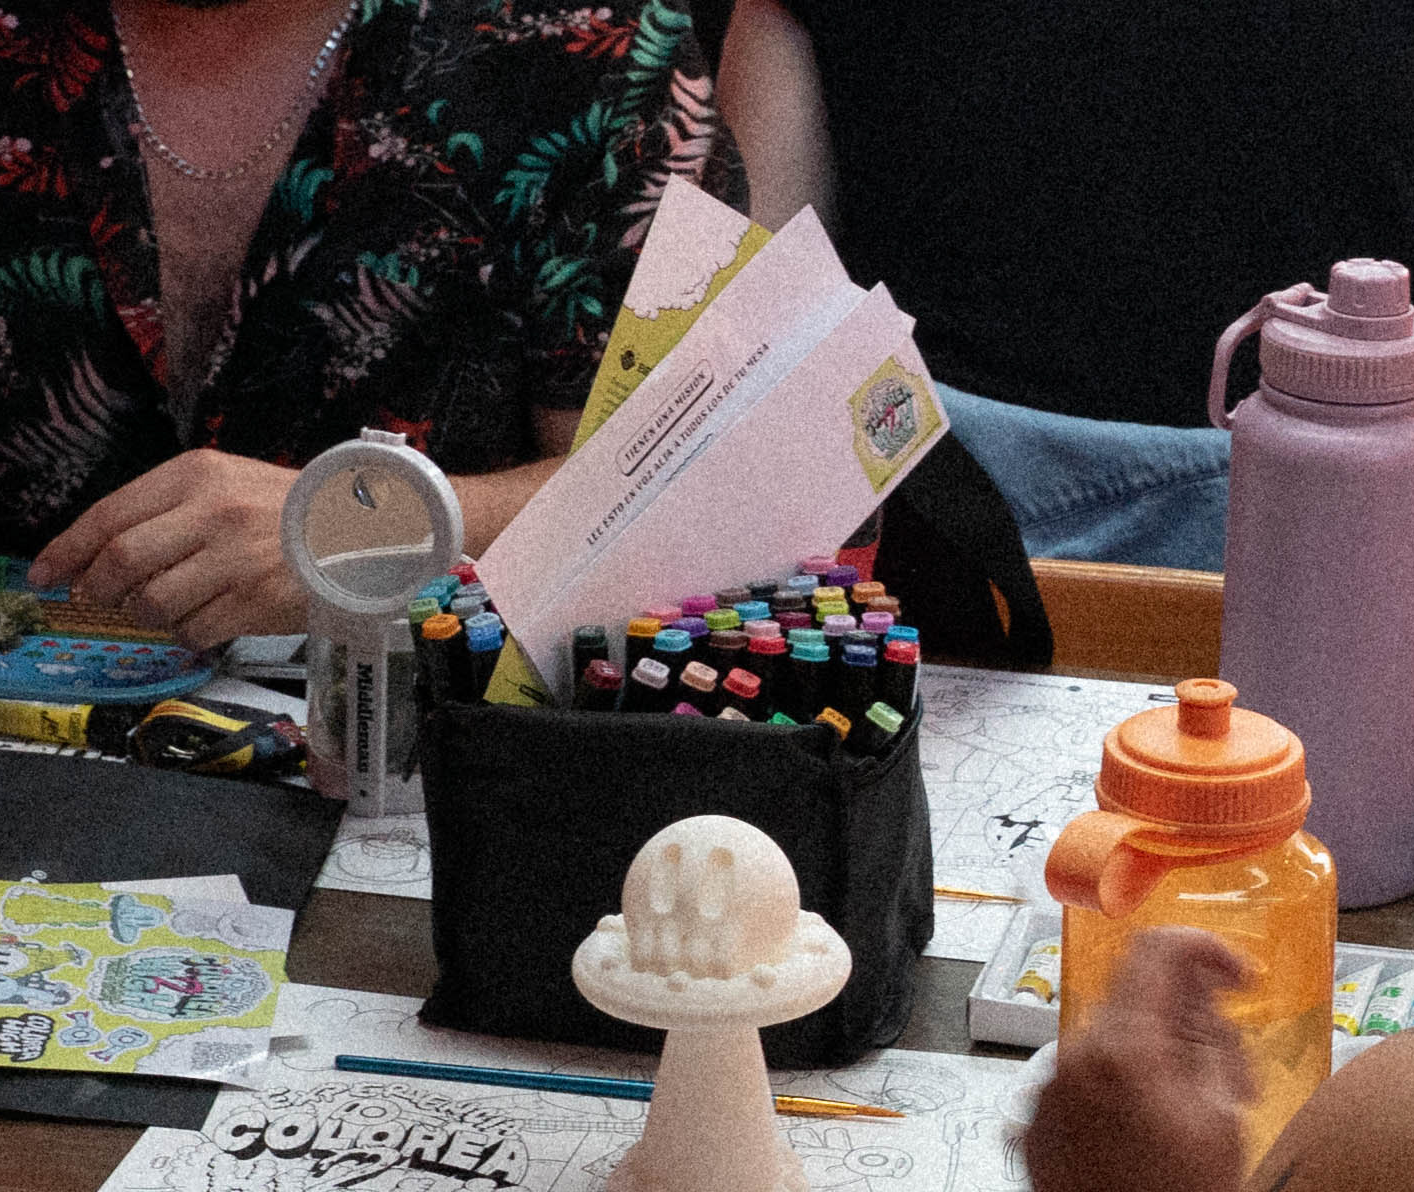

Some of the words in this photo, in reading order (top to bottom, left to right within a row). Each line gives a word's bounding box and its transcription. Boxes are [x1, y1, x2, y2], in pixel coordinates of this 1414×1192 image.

[655, 406, 676, 430] UNA
[602, 501, 625, 529] ESTO
[357, 663, 374, 773] Middleman
[213, 1109, 529, 1187] COLOREA
